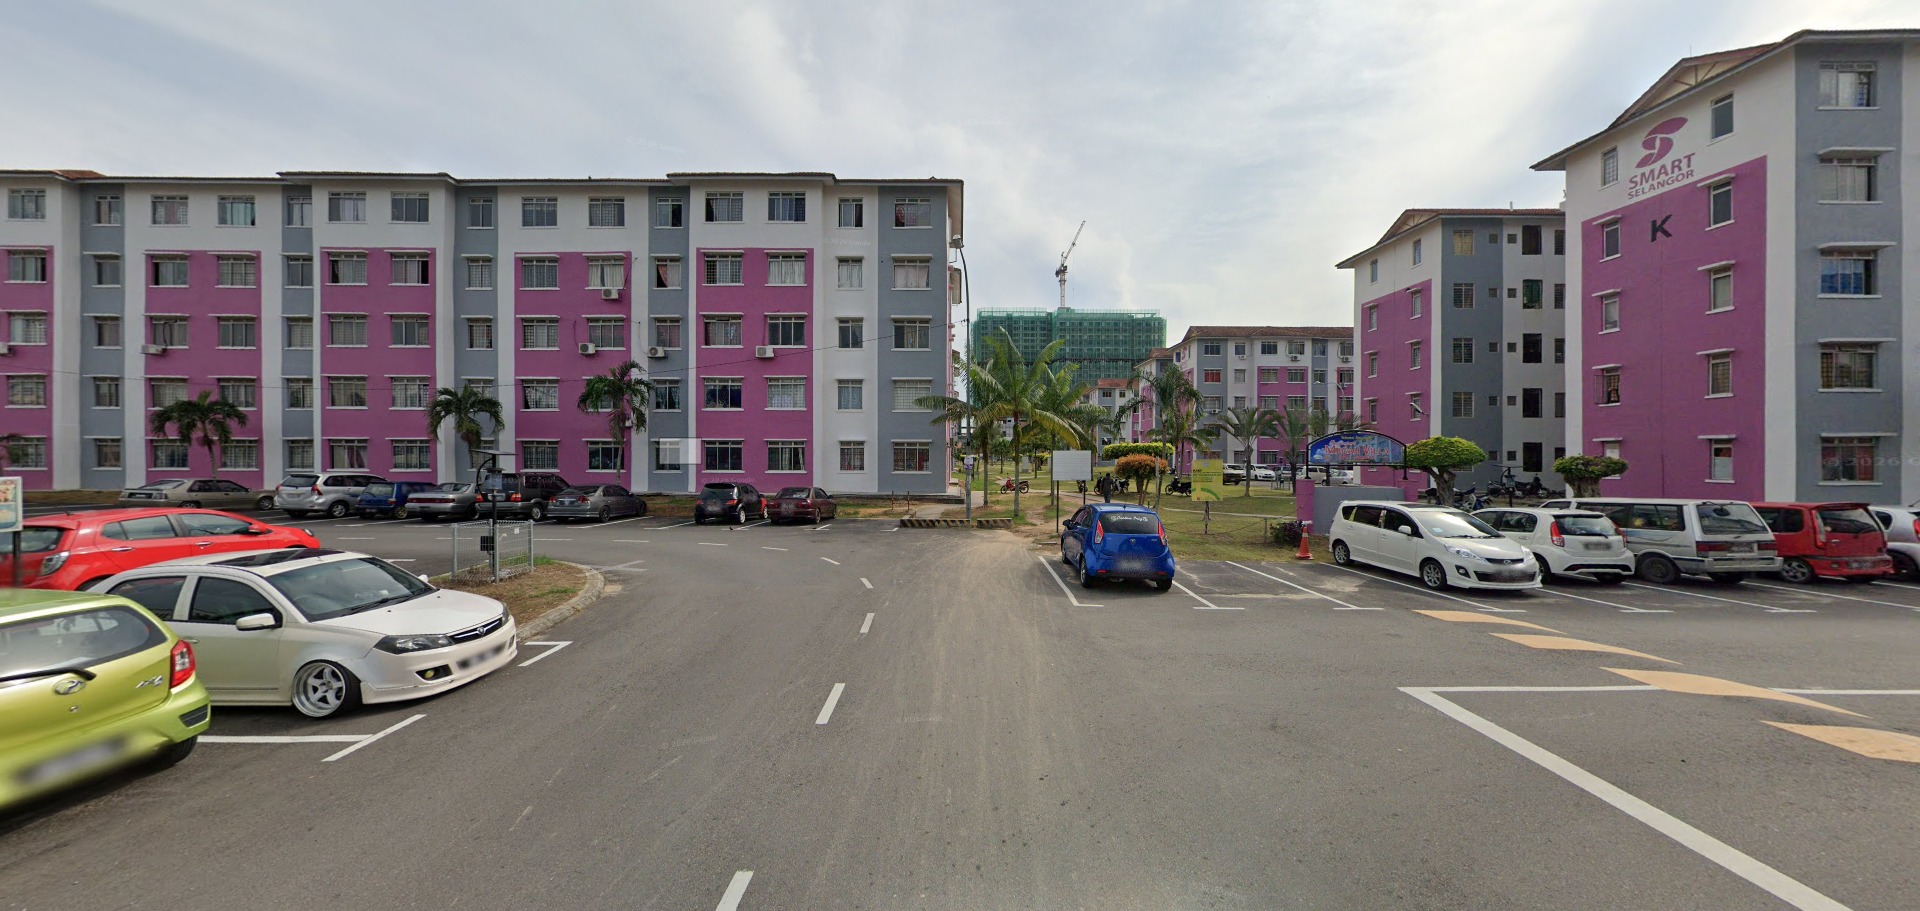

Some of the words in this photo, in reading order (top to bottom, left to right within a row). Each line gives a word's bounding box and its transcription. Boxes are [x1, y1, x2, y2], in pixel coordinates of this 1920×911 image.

[1628, 170, 1694, 200] SELANGOR
[1629, 152, 1696, 190] SMART
[1650, 213, 1673, 243] K
